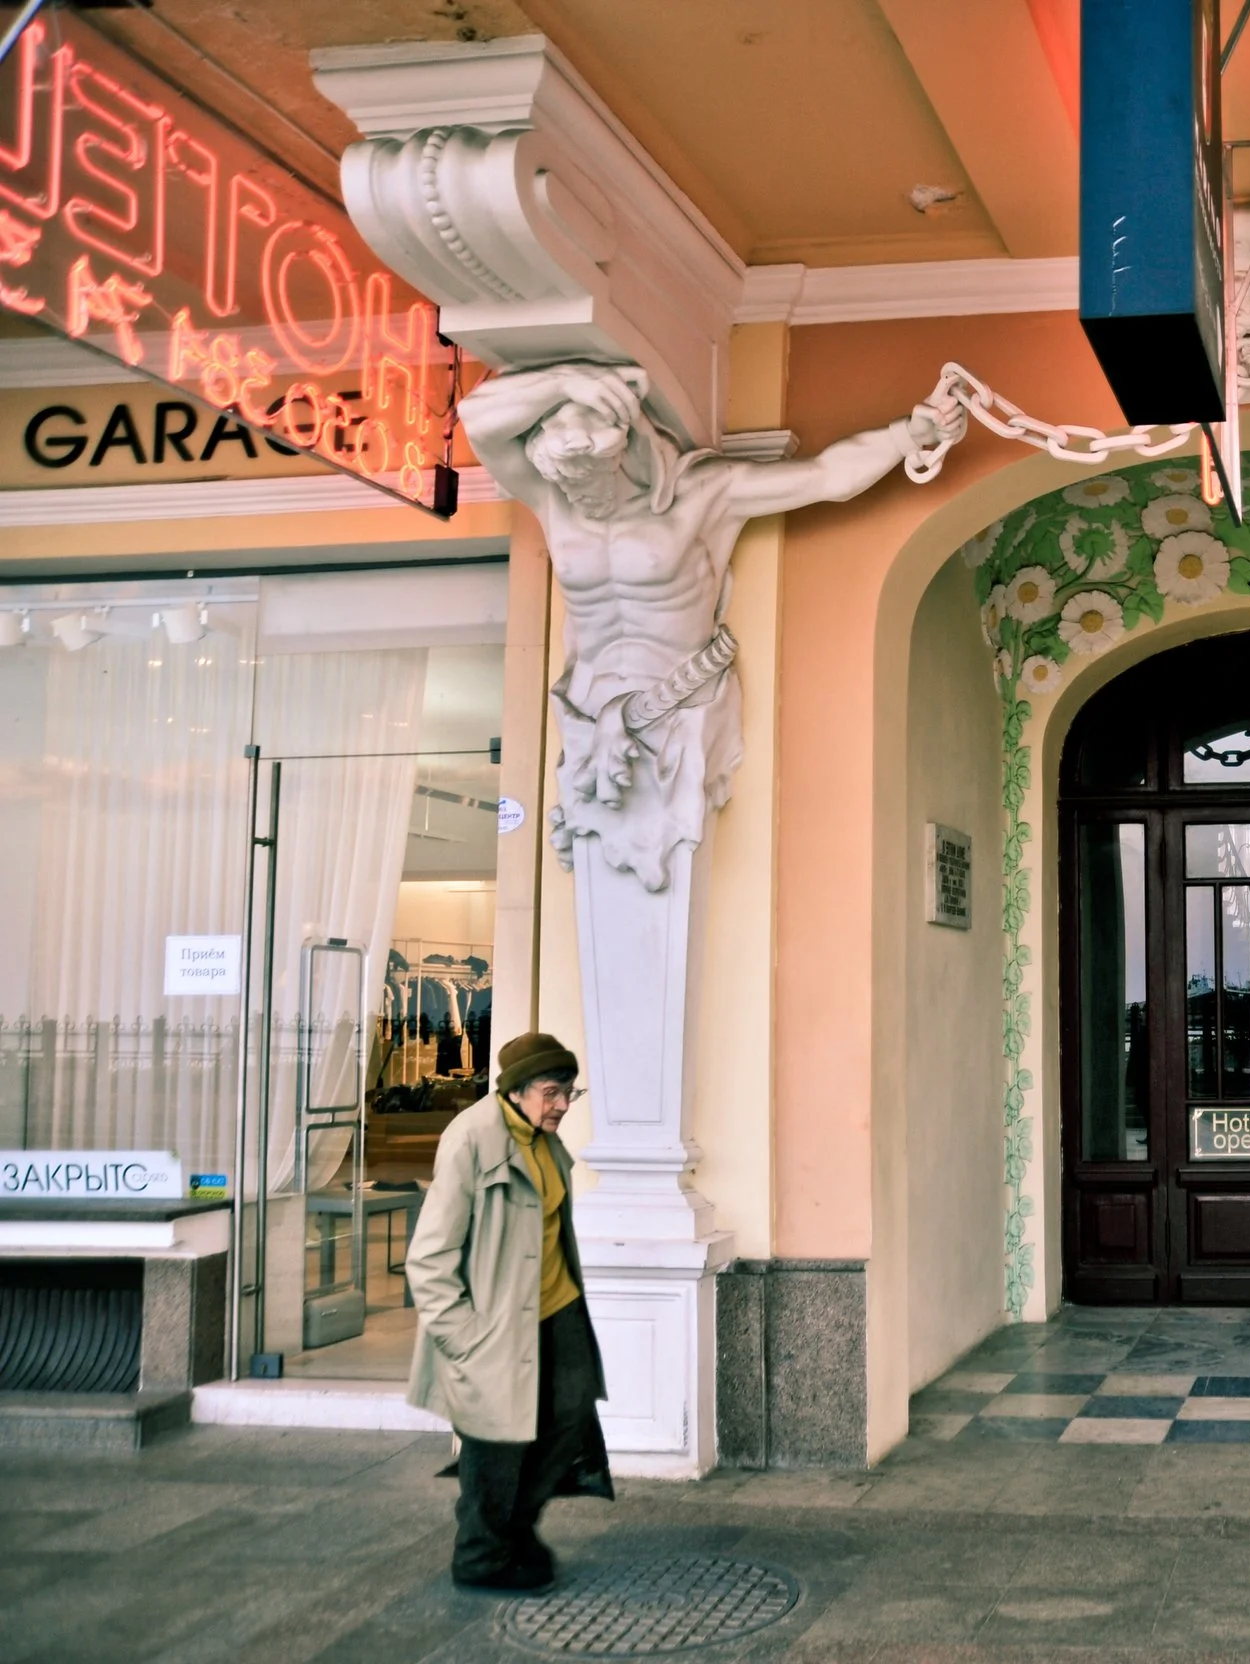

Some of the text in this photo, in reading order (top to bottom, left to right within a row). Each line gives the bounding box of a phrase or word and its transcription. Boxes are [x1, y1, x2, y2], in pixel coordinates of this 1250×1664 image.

[23, 389, 369, 469] GARAGE
[180, 947, 226, 962] Приём
[179, 966, 227, 979] товара
